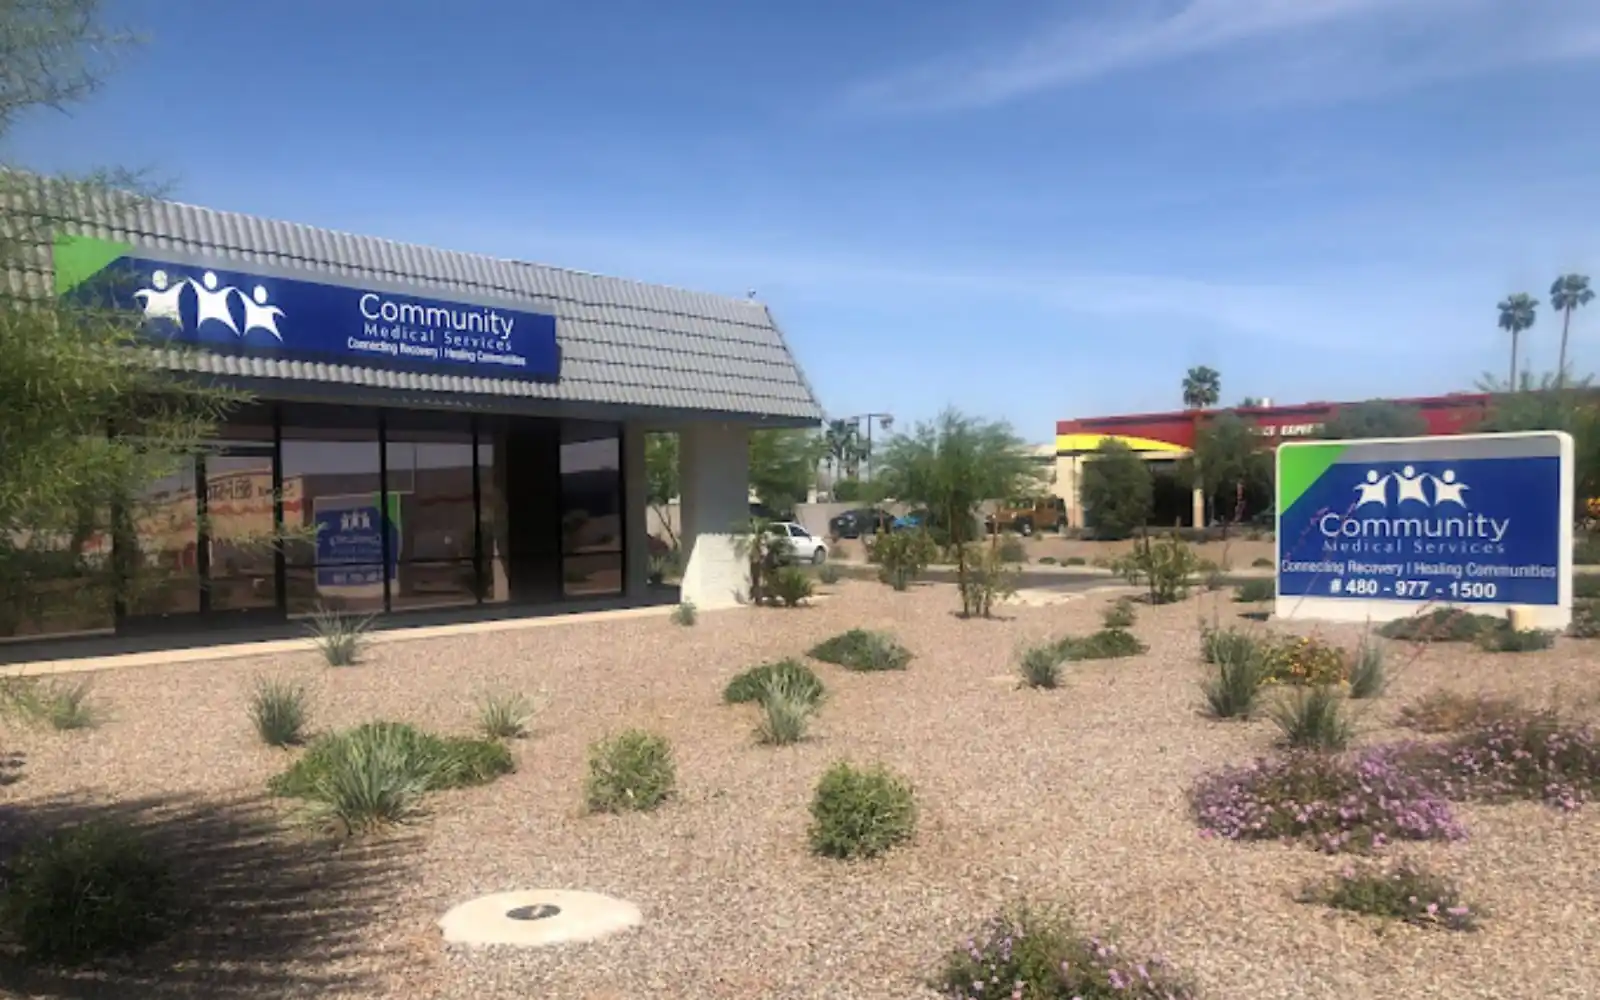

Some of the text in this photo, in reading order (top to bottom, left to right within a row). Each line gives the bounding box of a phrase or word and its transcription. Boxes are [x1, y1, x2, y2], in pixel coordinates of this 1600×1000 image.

[359, 293, 514, 339] Community
[364, 322, 512, 351] Medical Services
[1320, 511, 1510, 542] Community
[1322, 539, 1505, 554] Medical Services
[1281, 560, 1345, 576] Connecting
[1347, 560, 1404, 577] Recovery
[1415, 562, 1462, 579] Healing
[1466, 562, 1556, 578] Communities
[1345, 579, 1378, 595] 480
[1395, 580, 1430, 597] 977
[1449, 582, 1497, 598] 1500
